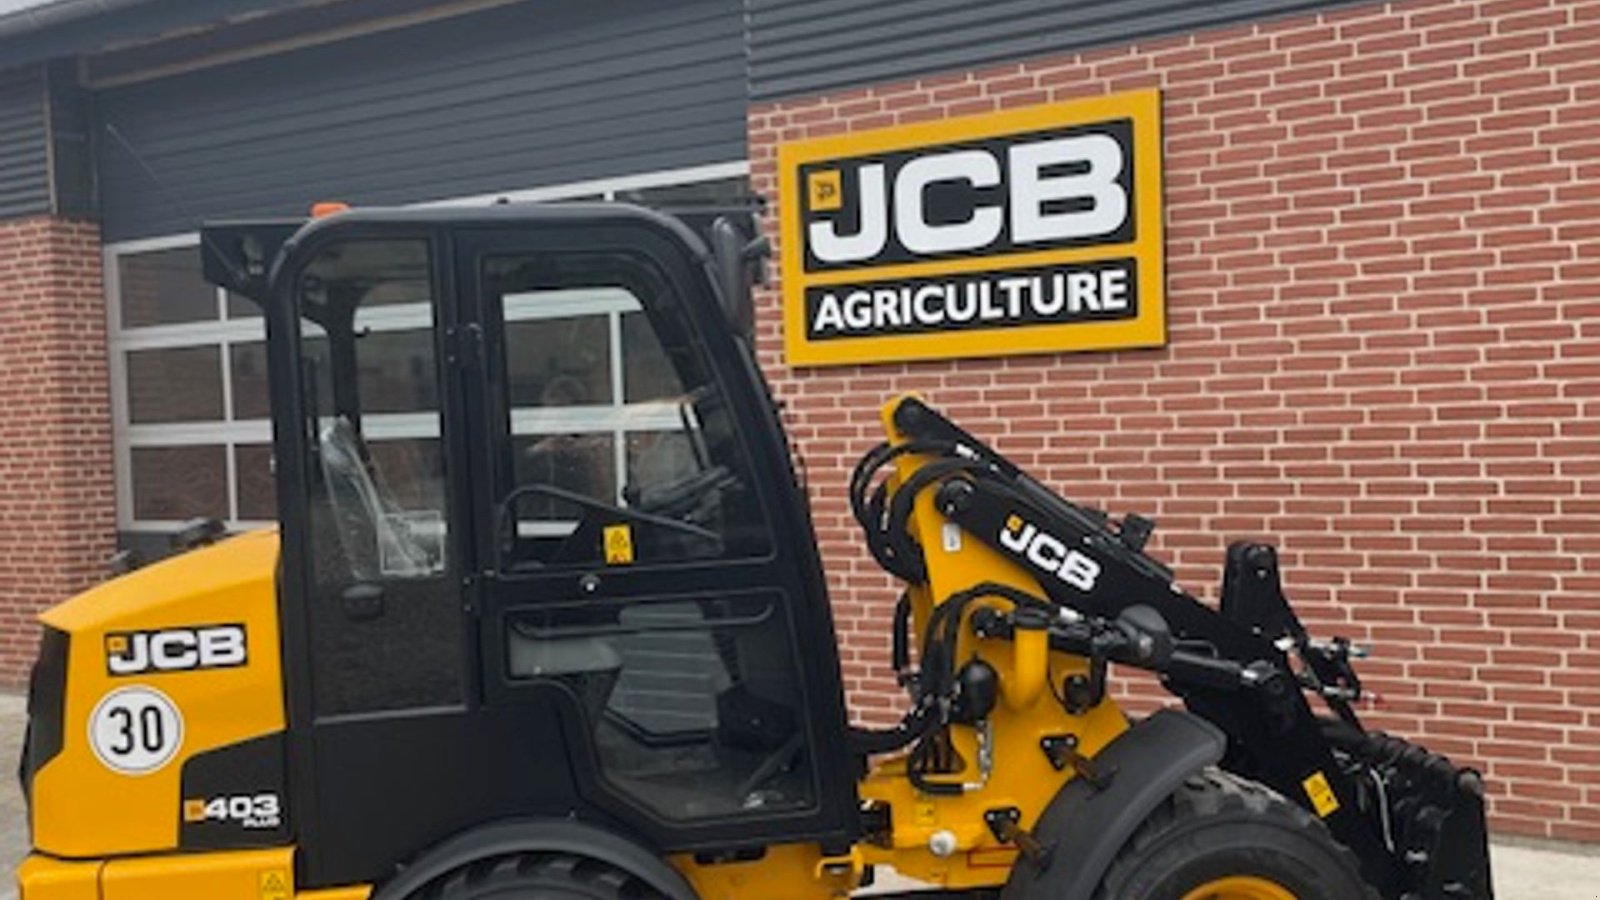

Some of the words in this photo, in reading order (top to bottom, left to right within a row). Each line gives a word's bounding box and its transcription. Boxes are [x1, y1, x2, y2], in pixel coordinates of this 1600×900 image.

[809, 133, 1128, 262] JCB
[814, 269, 1127, 331] AGRICULTURE
[1000, 523, 1101, 591] JCB
[109, 626, 246, 673] JCB
[108, 705, 165, 755] 30
[205, 793, 280, 819] 403
